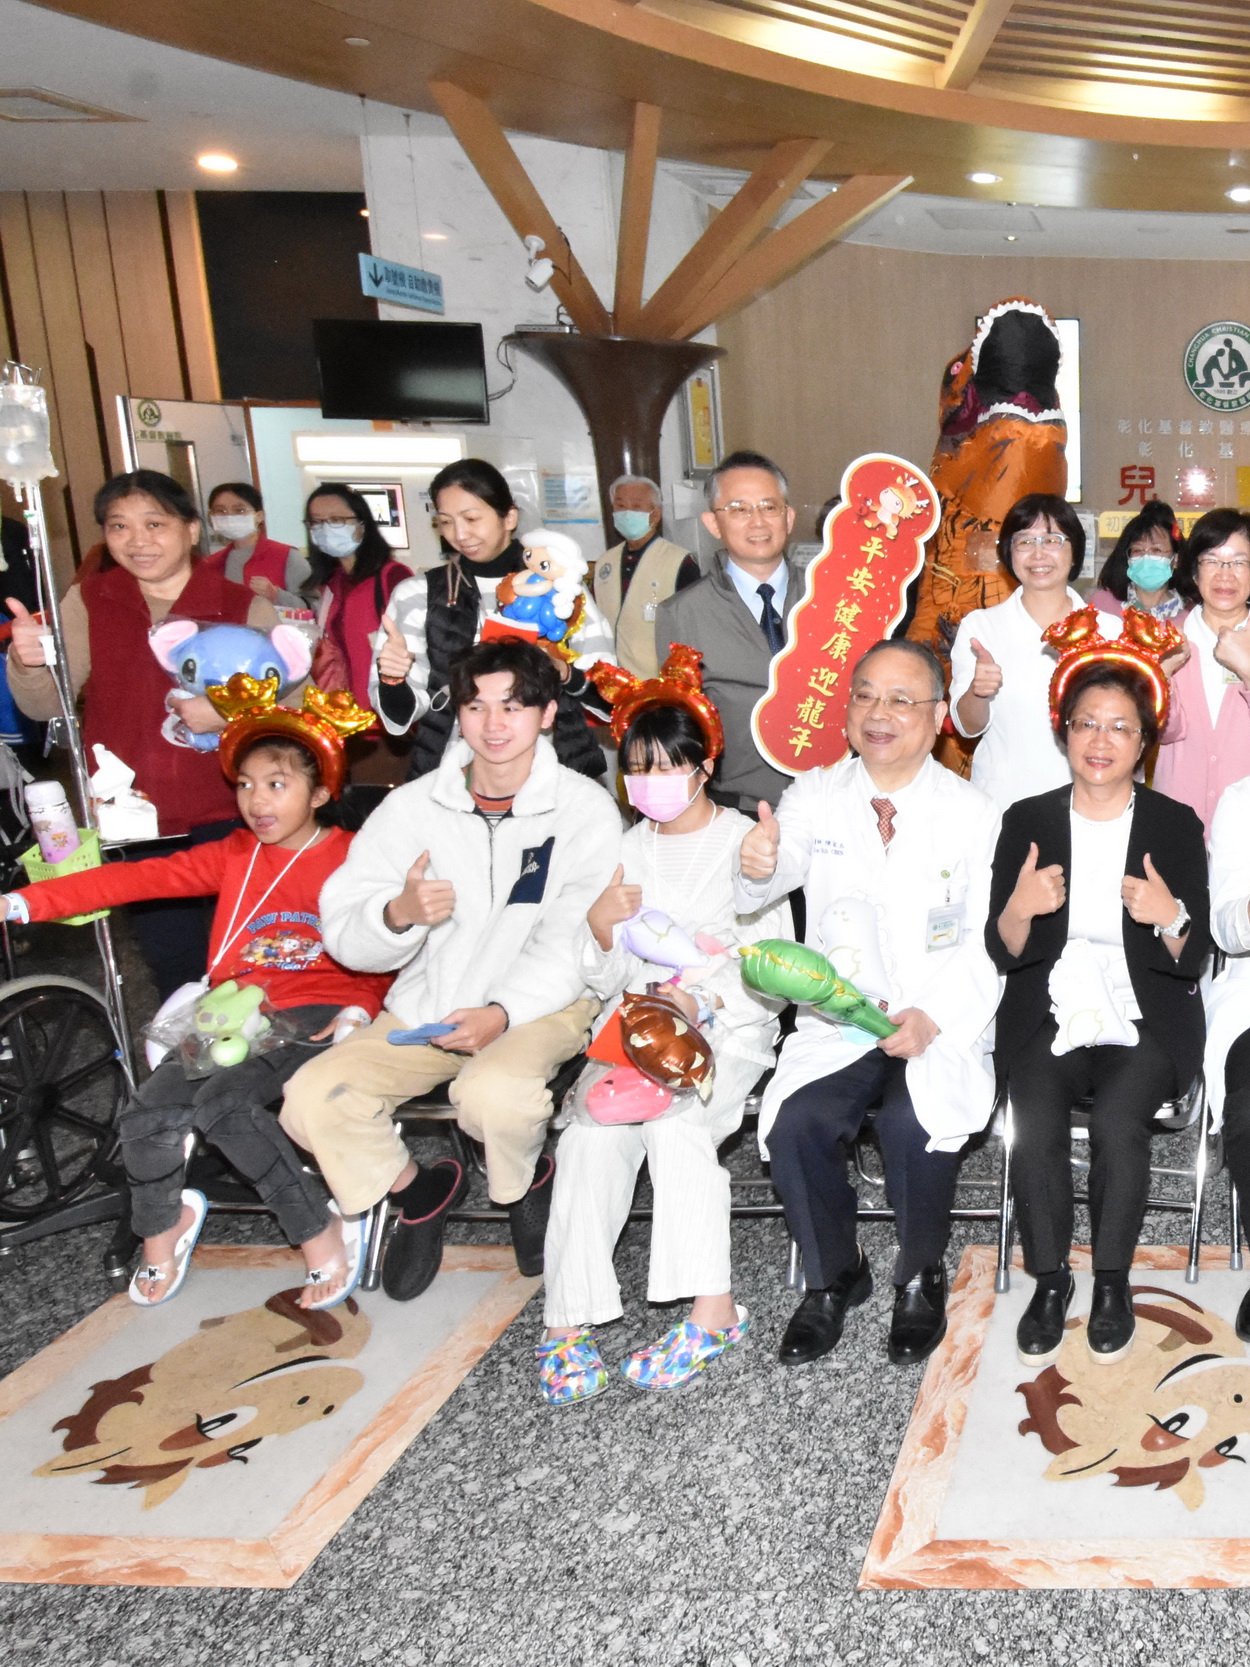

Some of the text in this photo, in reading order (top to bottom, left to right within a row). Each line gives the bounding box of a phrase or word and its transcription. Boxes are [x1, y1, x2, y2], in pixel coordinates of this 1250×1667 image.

[1187, 333, 1210, 368] CHANGHUA
[1211, 325, 1250, 339] CHRISTIAN
[788, 535, 886, 758] 平安健康迎龍年
[246, 911, 322, 935] PAW PATR
